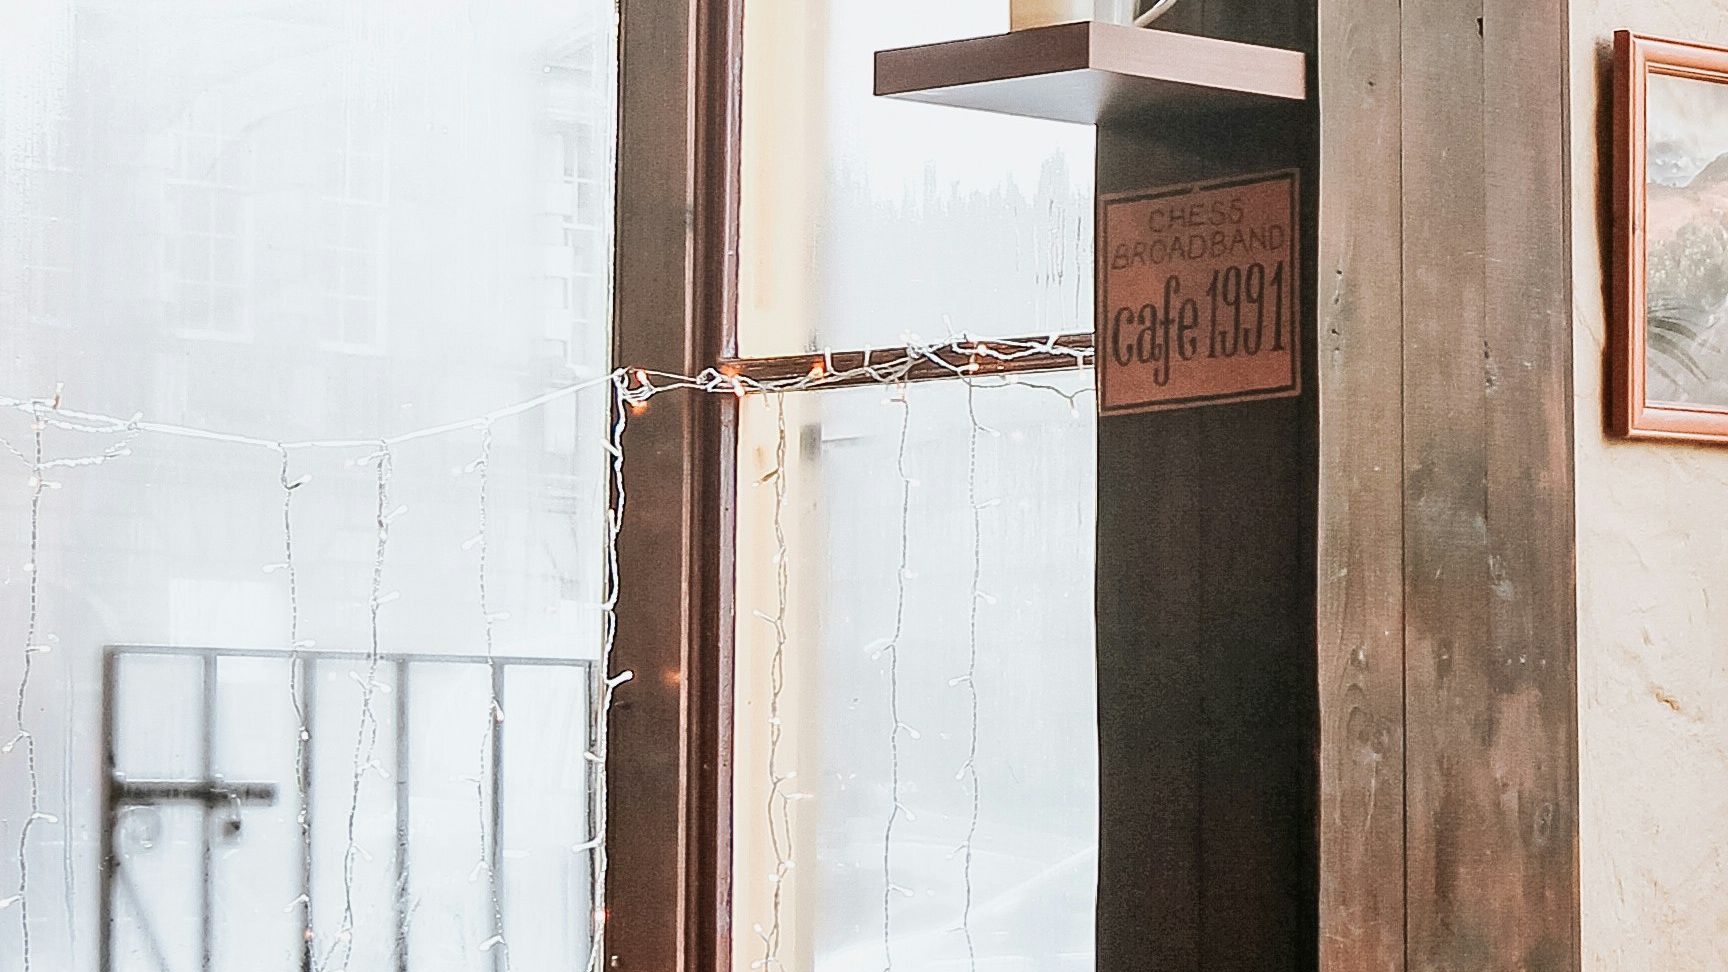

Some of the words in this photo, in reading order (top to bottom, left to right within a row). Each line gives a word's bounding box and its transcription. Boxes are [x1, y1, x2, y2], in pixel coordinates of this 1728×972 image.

[1148, 197, 1245, 233] CHESS
[1111, 224, 1284, 270] BROADBAND
[1111, 274, 1199, 387] cafe
[1206, 260, 1285, 359] 1991
